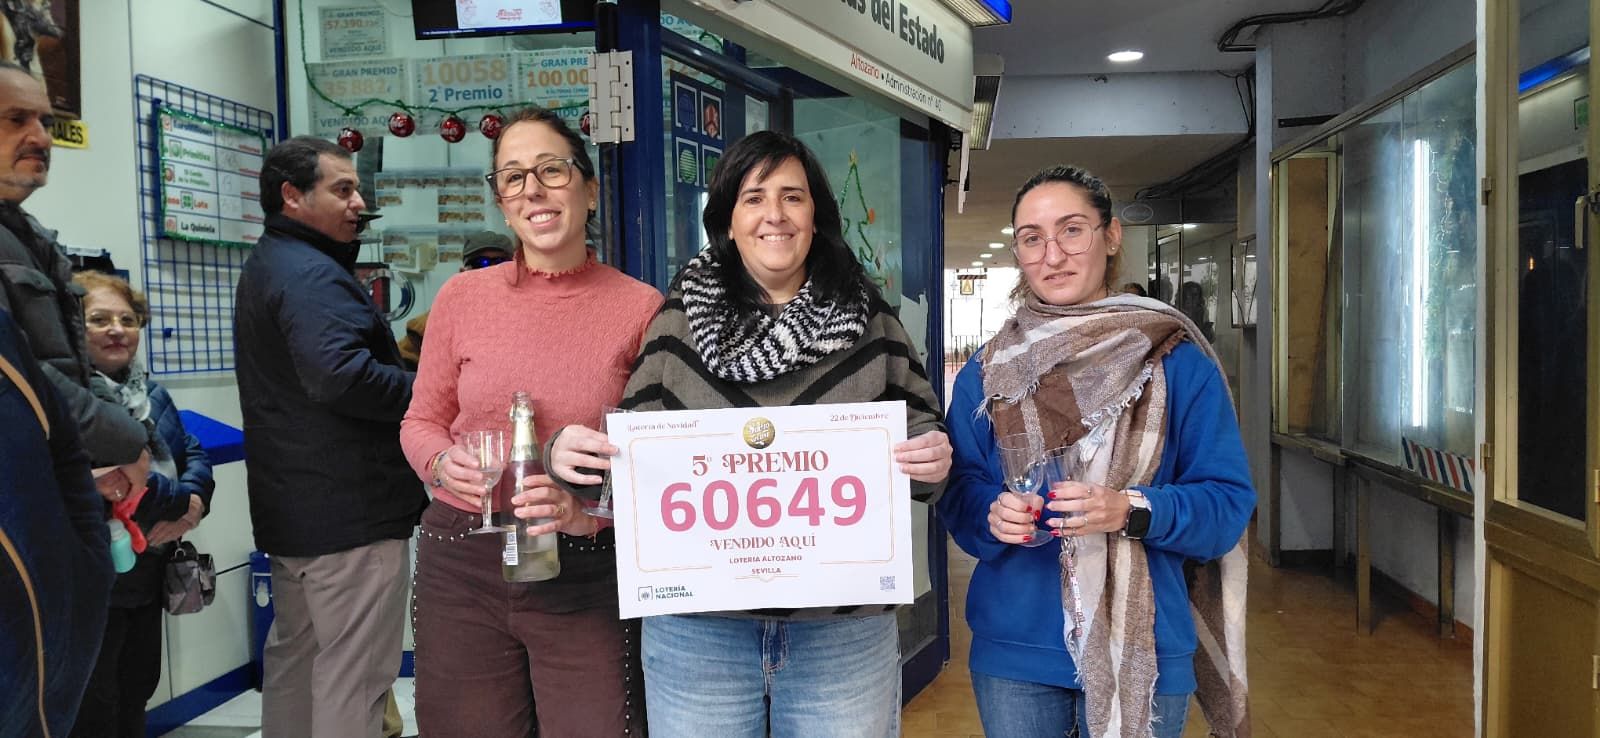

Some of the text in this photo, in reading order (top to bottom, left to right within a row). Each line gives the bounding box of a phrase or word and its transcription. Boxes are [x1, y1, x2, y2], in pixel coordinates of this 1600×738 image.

[900, 2, 945, 64] Estado
[541, 59, 568, 67] GRAN
[850, 52, 880, 79] Altozano
[332, 66, 398, 78] GRAN PREMIO
[424, 59, 507, 86] 10058
[444, 85, 503, 101] Premio
[667, 419, 699, 430] Navidad
[722, 450, 829, 474] PREMIO
[660, 475, 867, 532] 60649
[710, 533, 816, 551] VENDIDO AQUÍ
[762, 554, 803, 562] ALTOZANO
[655, 591, 693, 599] NACIONAL
